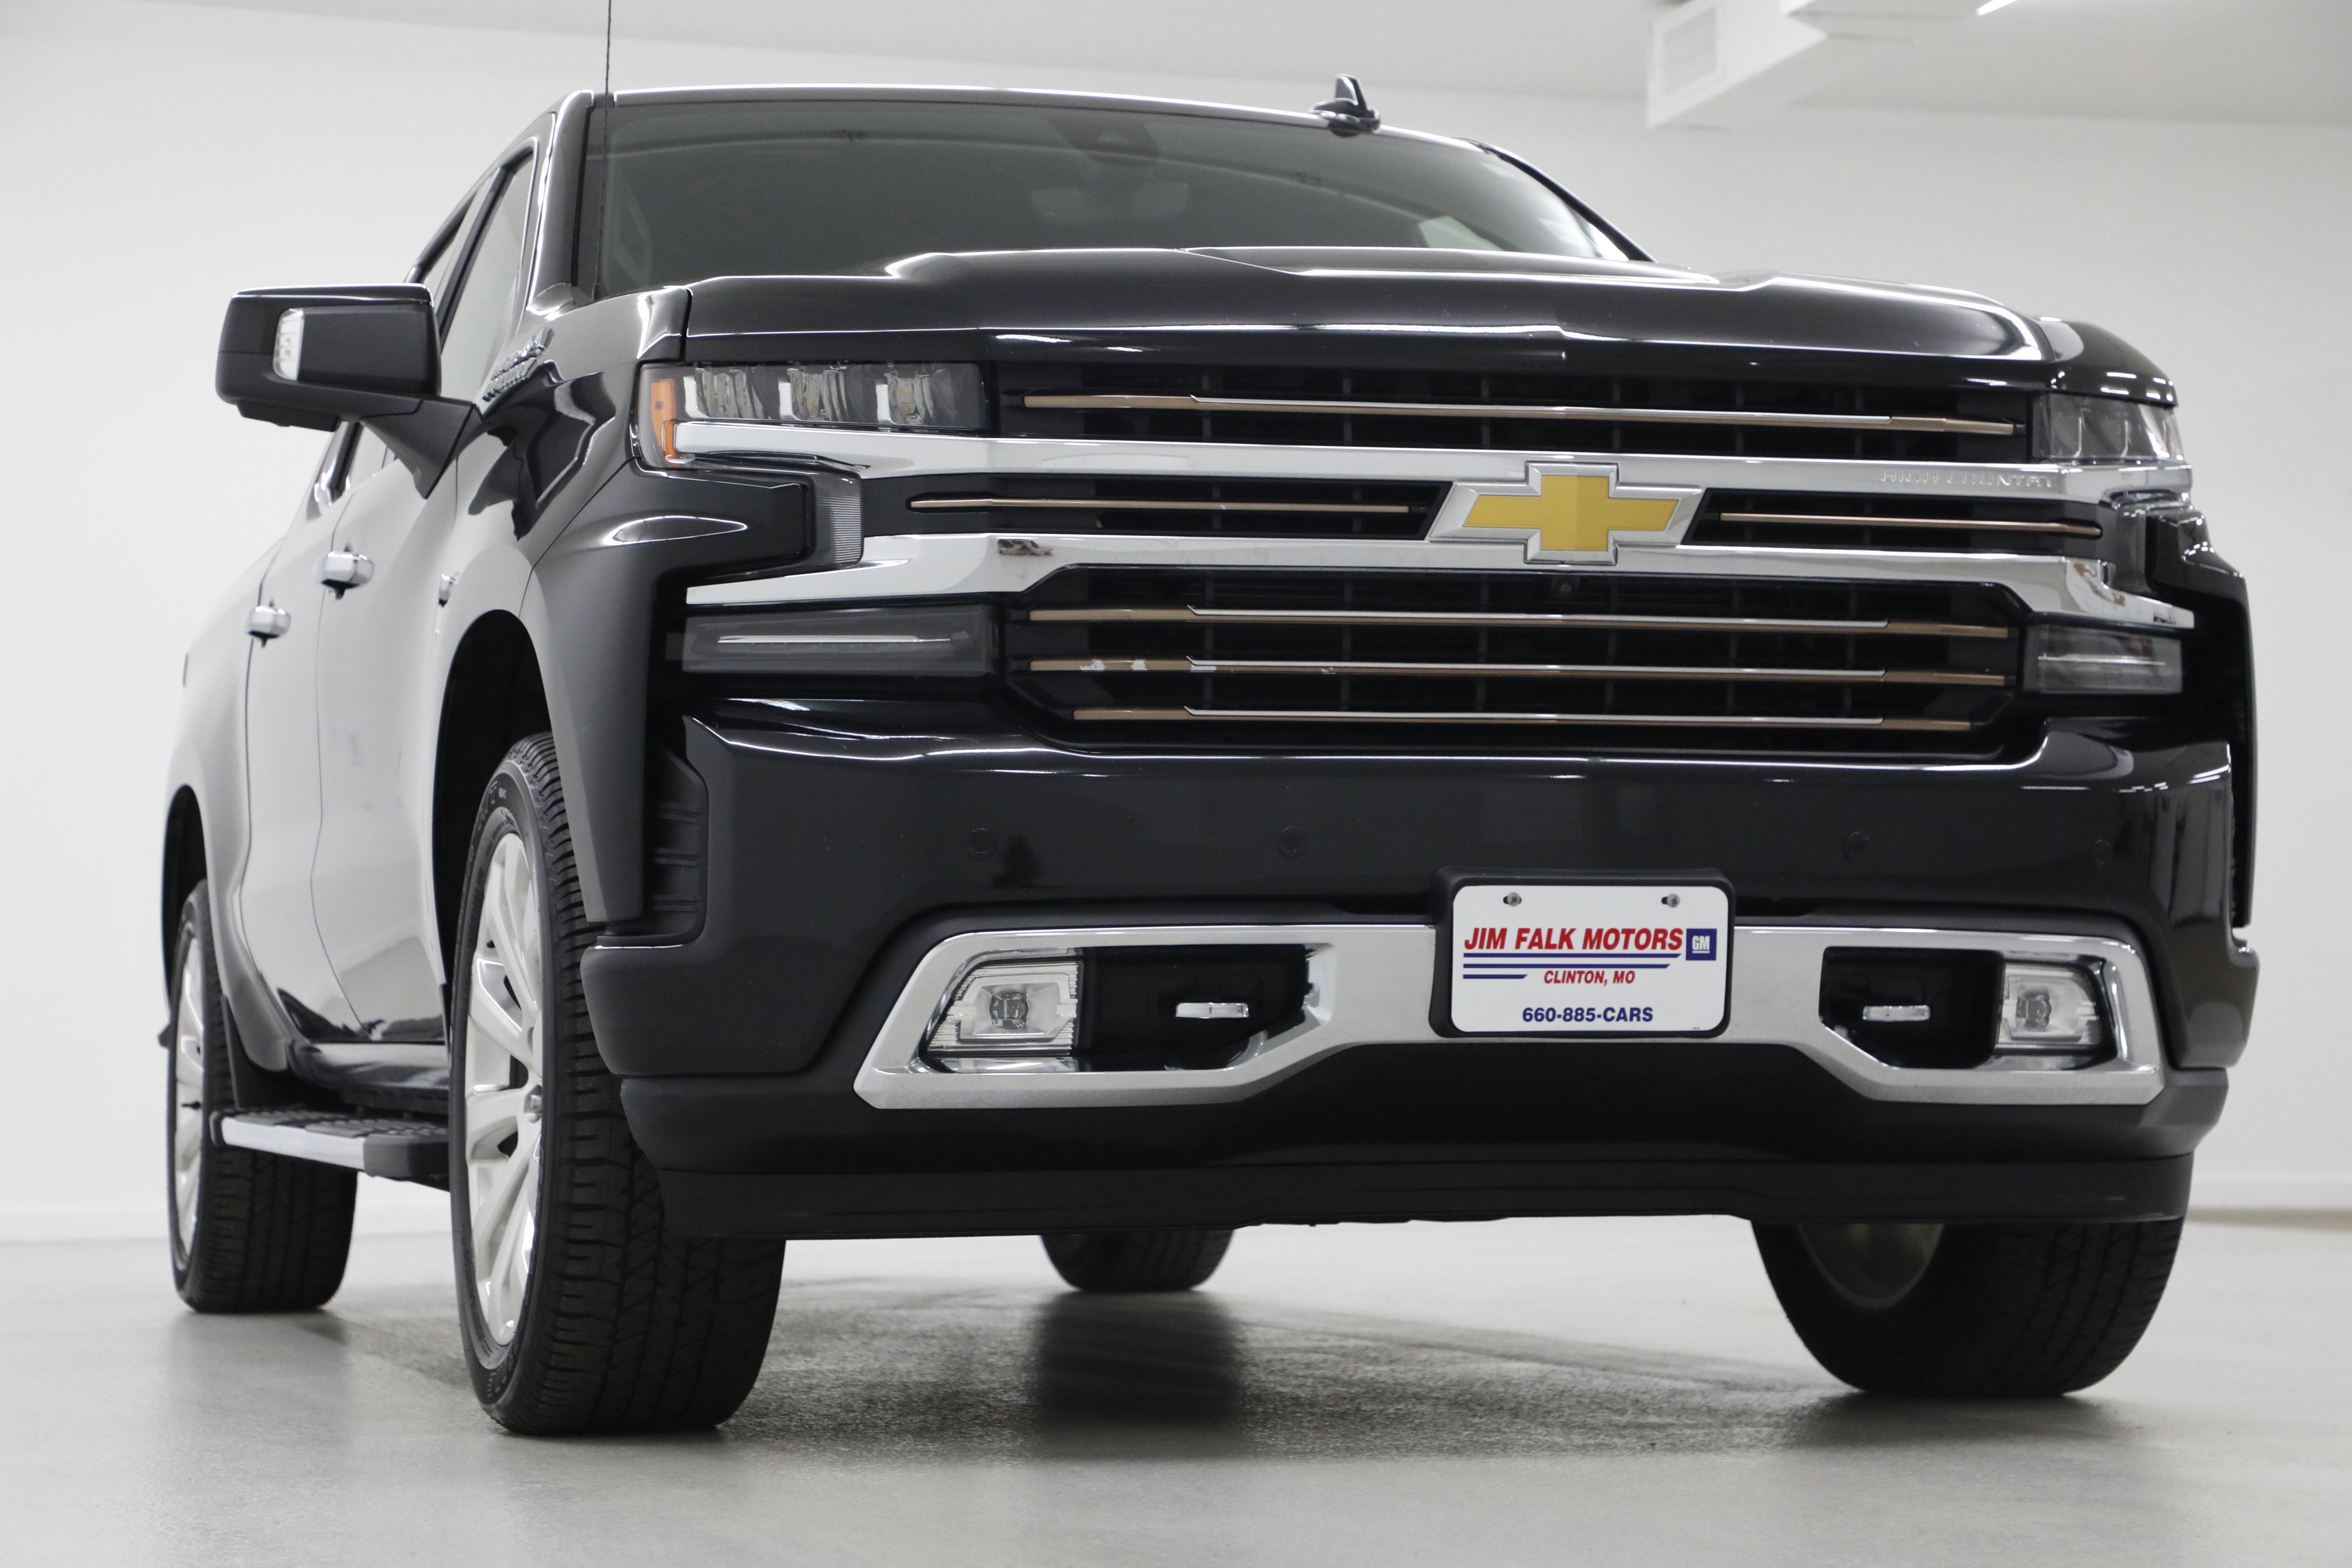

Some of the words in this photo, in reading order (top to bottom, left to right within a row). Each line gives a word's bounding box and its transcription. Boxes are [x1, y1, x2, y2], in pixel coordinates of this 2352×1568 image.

[1464, 928, 1507, 950] JIM
[1515, 928, 1576, 950] FALK
[1582, 928, 1683, 951] MOTORS
[1692, 935, 1711, 951] GM
[1544, 970, 1607, 986] CLINTON,
[1613, 971, 1635, 984] MO
[1522, 1007, 1653, 1022] 660-885-CARS
